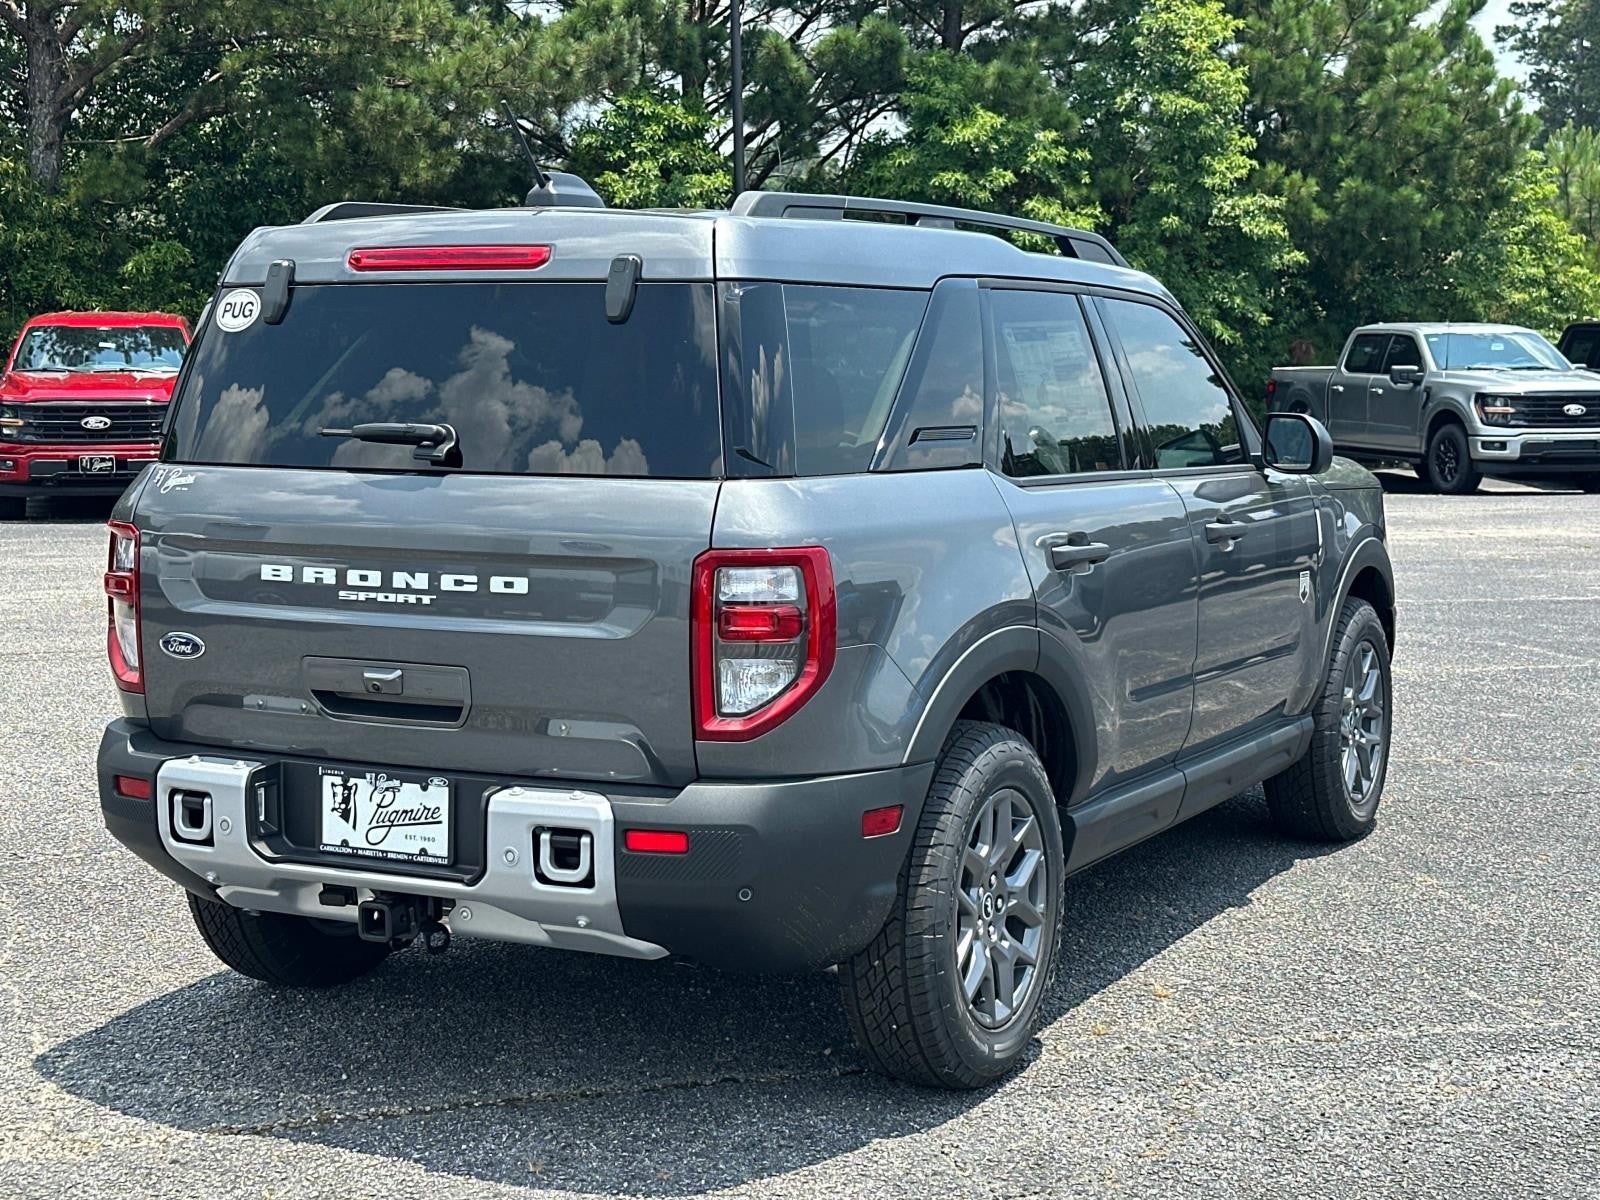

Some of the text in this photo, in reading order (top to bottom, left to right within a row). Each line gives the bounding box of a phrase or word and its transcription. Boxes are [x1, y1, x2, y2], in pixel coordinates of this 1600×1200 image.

[222, 301, 254, 319] PUG
[260, 564, 529, 594] BRONCO
[338, 590, 437, 605] SPORT
[168, 637, 193, 653] Ford
[365, 786, 443, 846] Pugmire
[404, 833, 418, 841] EST.
[319, 844, 448, 865] CARROLLTON MARIETTA BREMEN CARTERSVILLE
